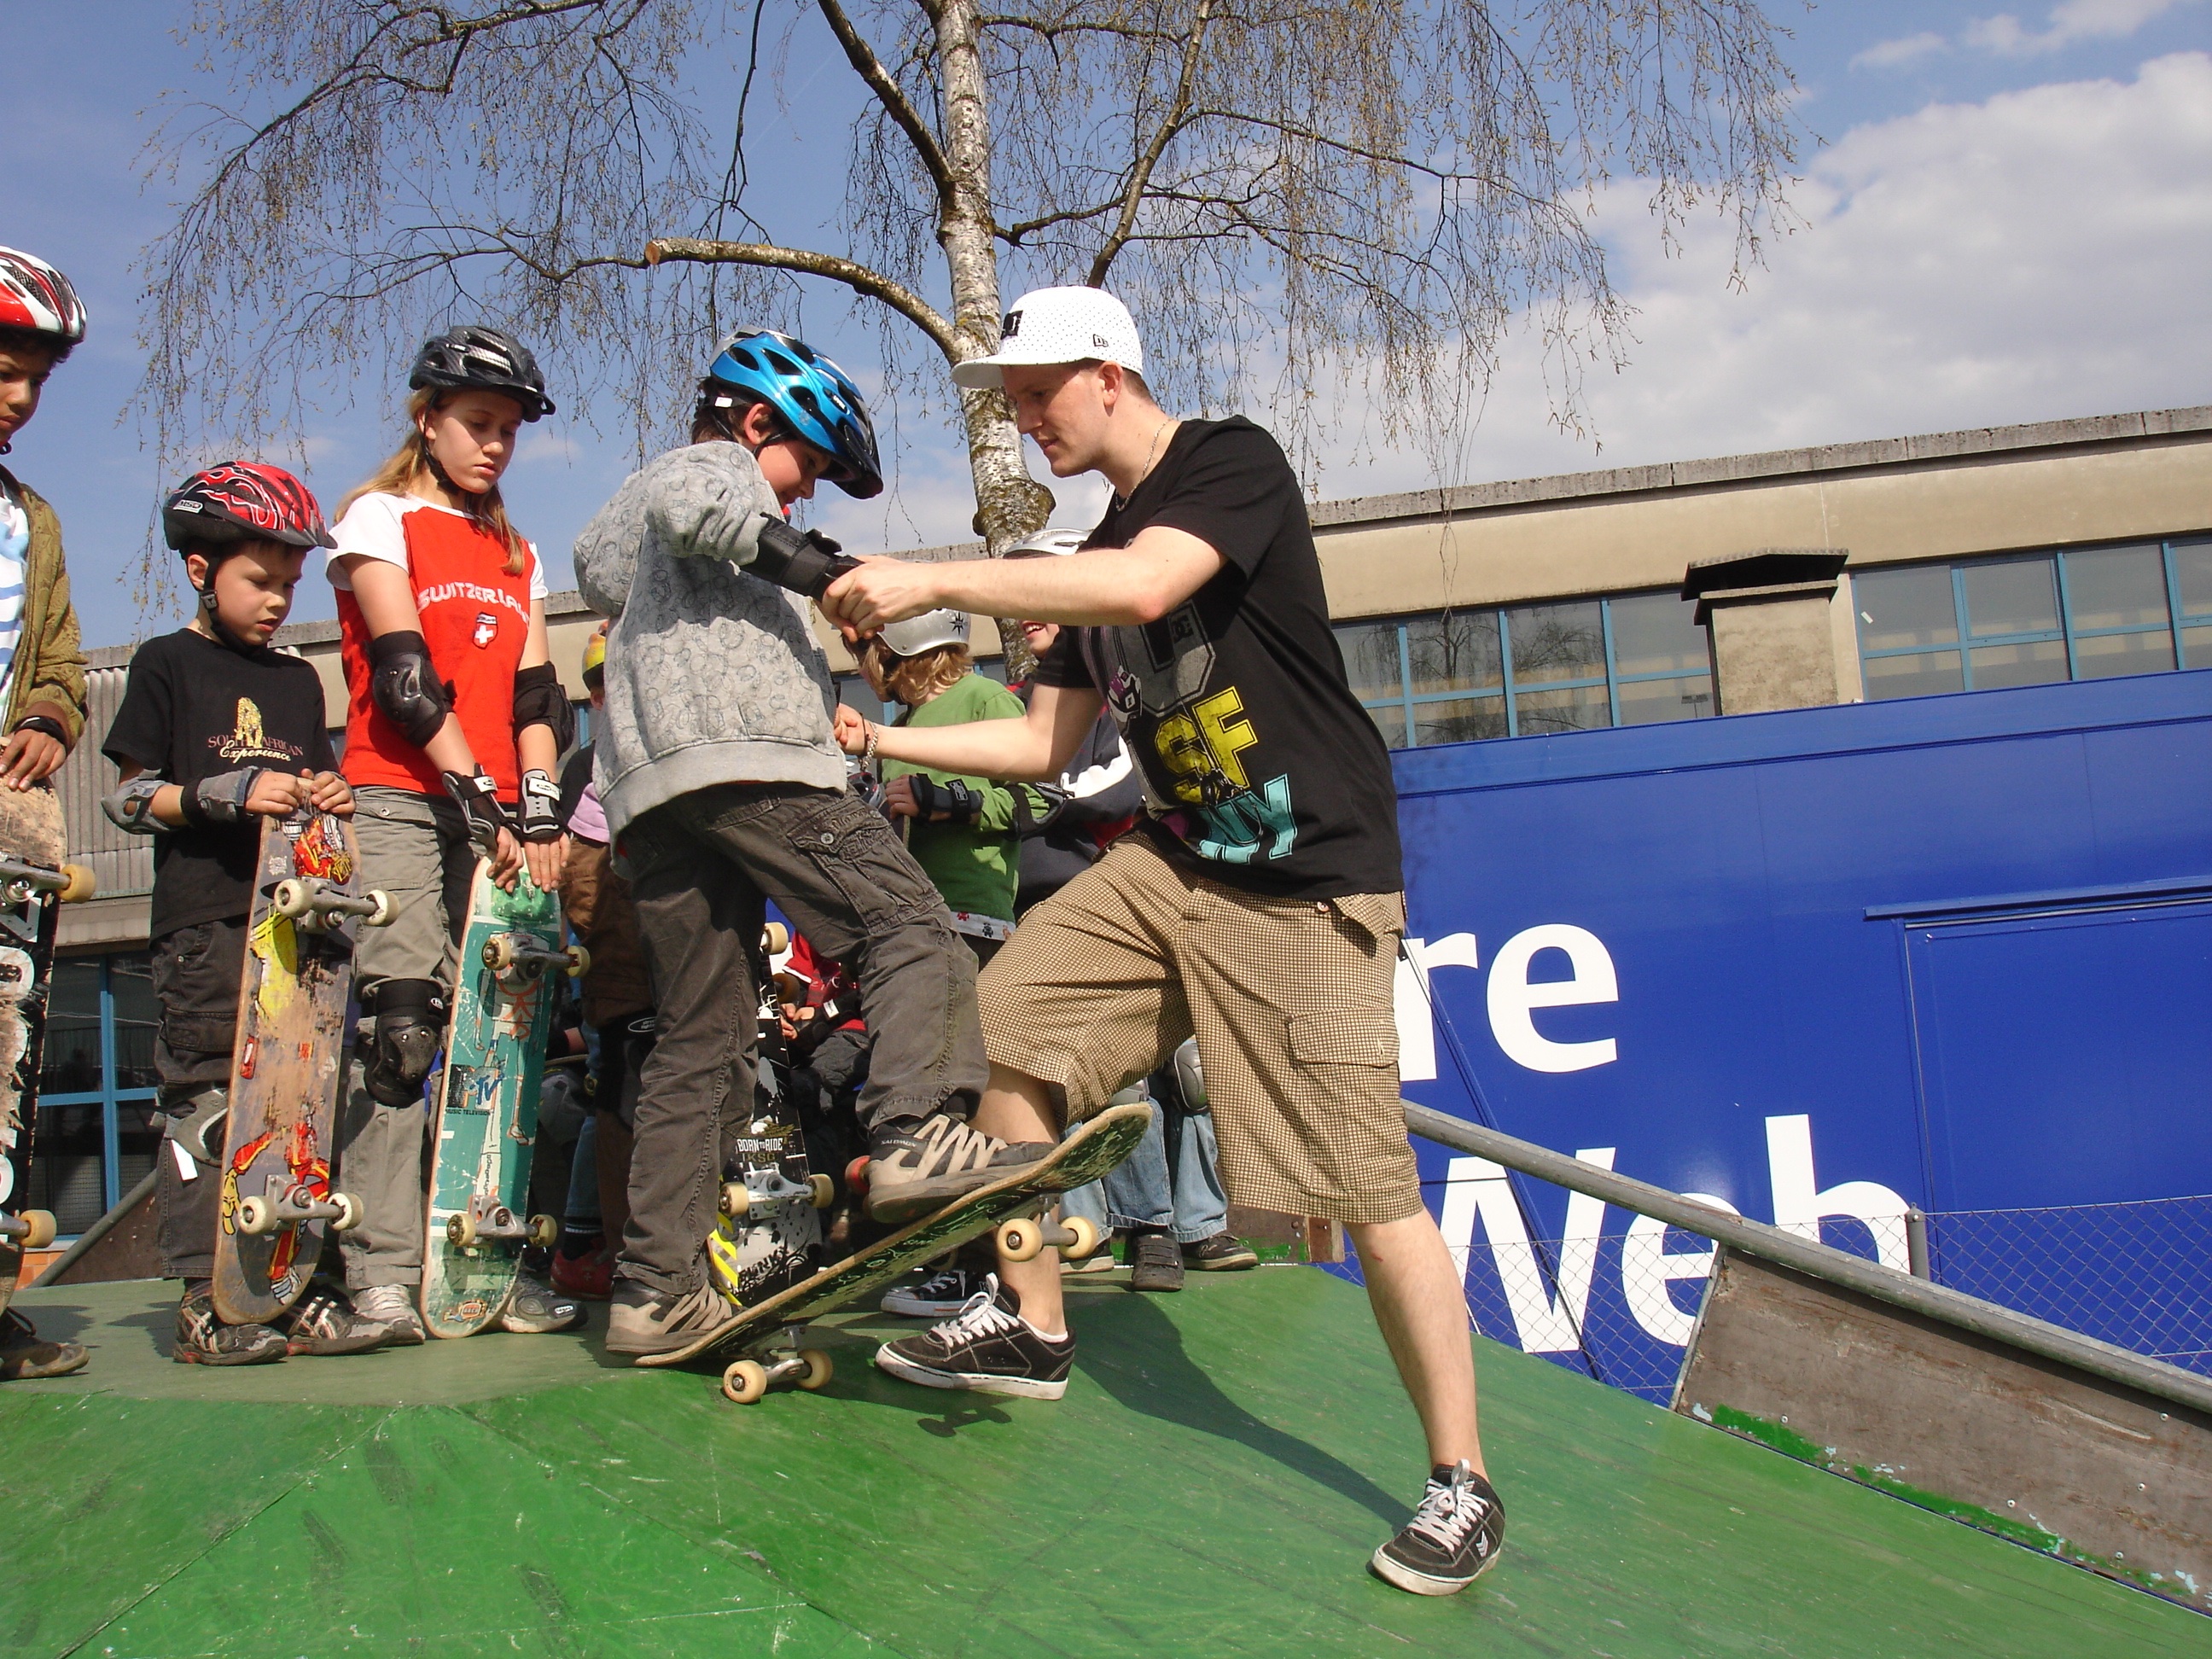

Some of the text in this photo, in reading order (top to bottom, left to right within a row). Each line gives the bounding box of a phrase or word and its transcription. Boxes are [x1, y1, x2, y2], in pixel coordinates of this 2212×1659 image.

[1155, 685, 1259, 806] SF
[736, 1138, 760, 1152] BORN
[765, 1138, 783, 1151] RIDE
